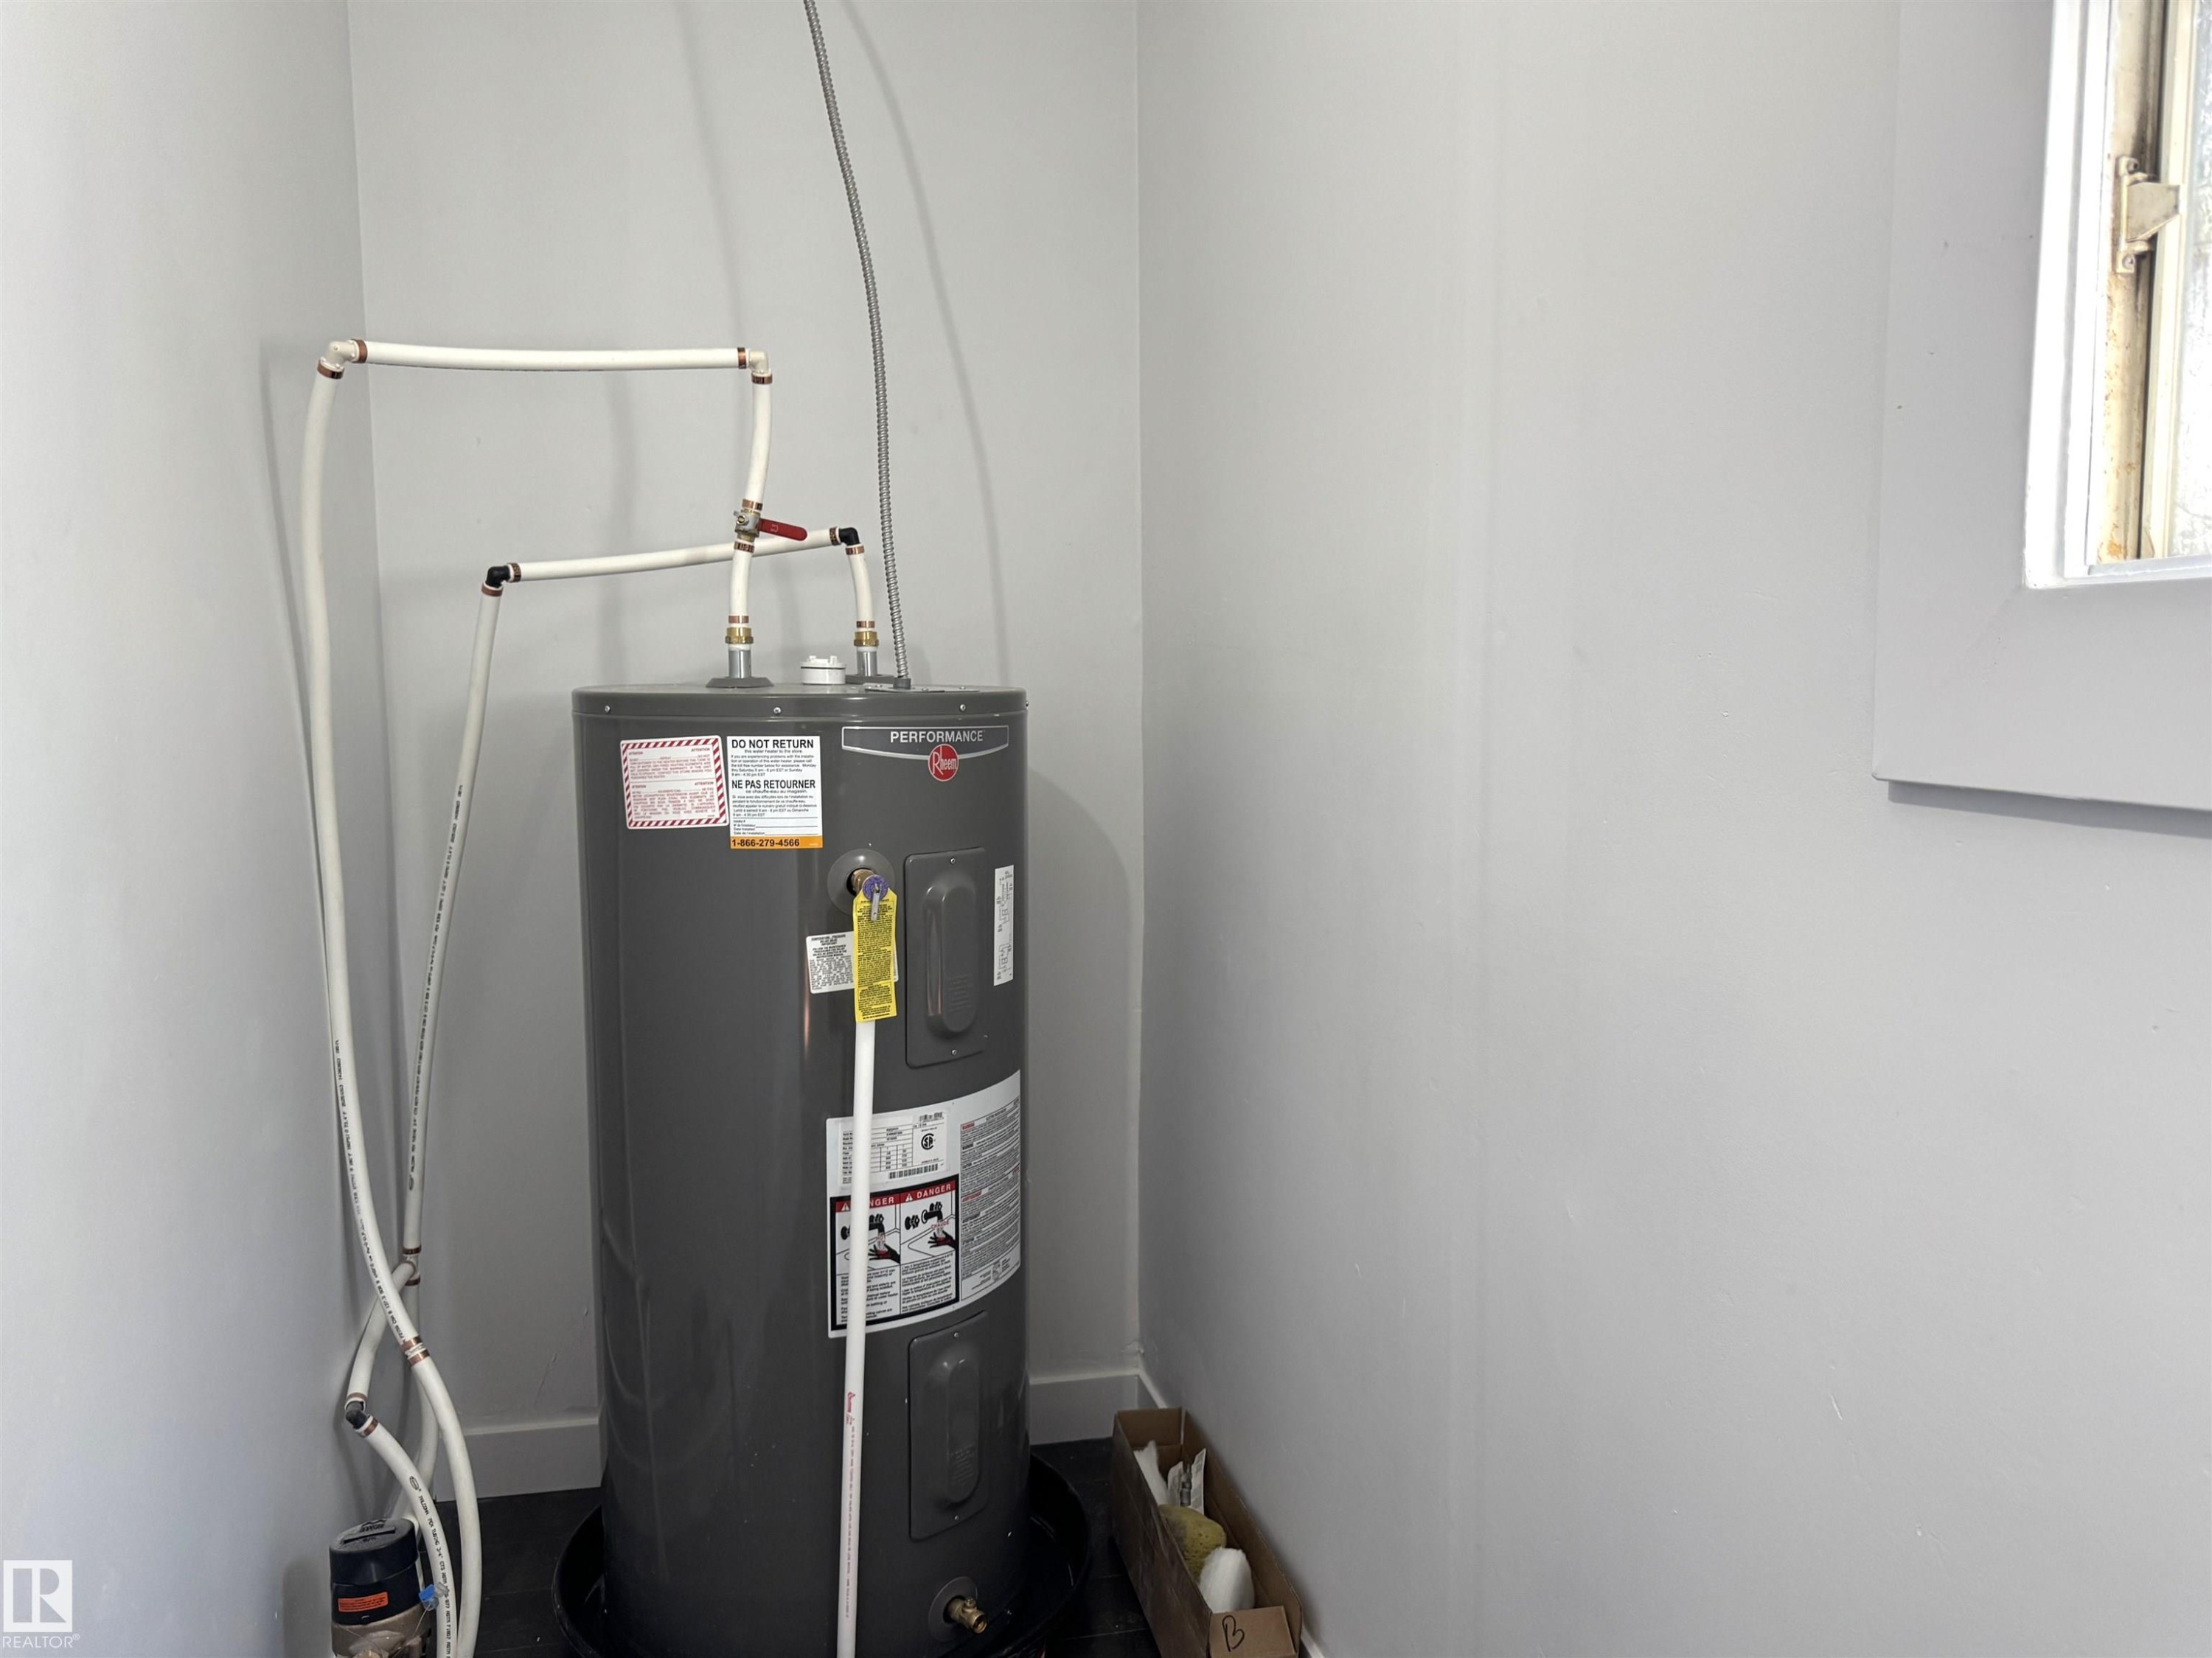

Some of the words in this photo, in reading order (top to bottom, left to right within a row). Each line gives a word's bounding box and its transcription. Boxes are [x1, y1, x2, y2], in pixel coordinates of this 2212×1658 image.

[890, 731, 984, 743] PERFORMANCE
[731, 739, 746, 749] DO
[749, 739, 769, 749] NOT
[773, 739, 814, 749] RETURN
[932, 745, 958, 775] Rheem
[732, 780, 743, 789] NE
[745, 780, 761, 789] PAS
[764, 780, 816, 789] RETOURNER
[731, 839, 800, 847] 1-866-279-4566
[917, 1183, 952, 1199] DANGER
[870, 1196, 894, 1207] NGER
[1222, 1614, 1245, 1652] B
